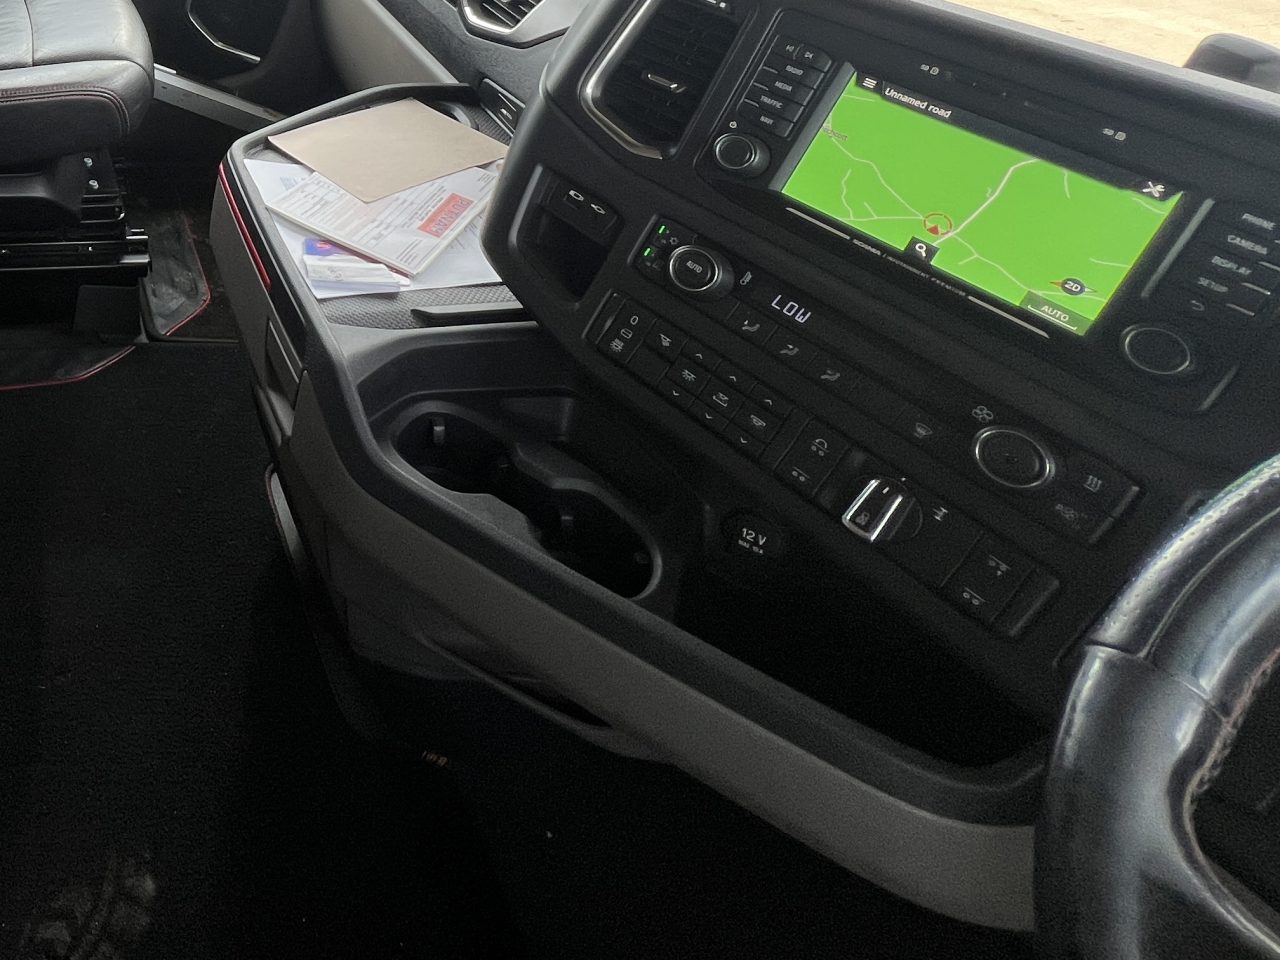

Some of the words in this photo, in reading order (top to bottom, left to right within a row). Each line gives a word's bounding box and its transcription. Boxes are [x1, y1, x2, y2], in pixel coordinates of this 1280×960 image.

[774, 80, 793, 92] MEDIA
[760, 95, 784, 110] TRAFFIC
[884, 87, 928, 110] Unnamed
[927, 103, 952, 119] road
[1227, 234, 1268, 255] CAMERA
[686, 260, 703, 274] AUTO
[1064, 280, 1081, 292] 2D
[771, 294, 812, 324] LOW
[1040, 305, 1070, 321] AUTO
[741, 527, 756, 542] 12
[758, 534, 767, 546] V
